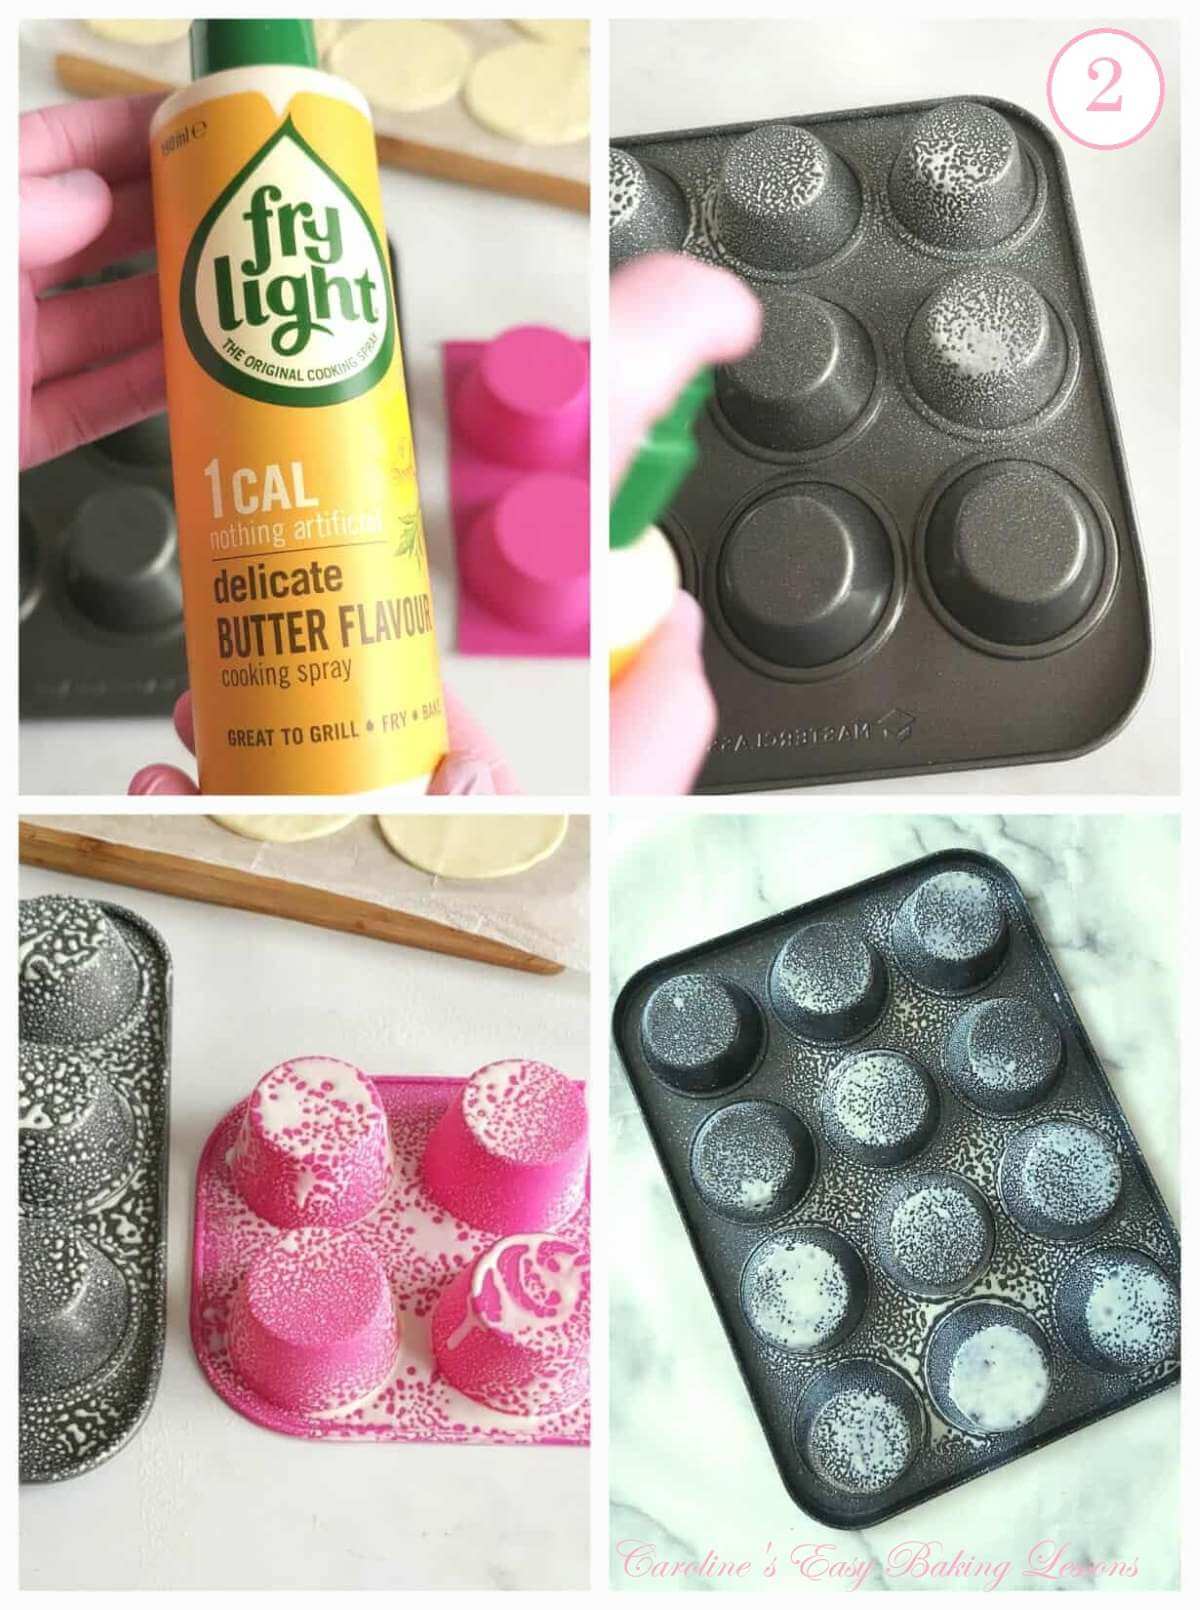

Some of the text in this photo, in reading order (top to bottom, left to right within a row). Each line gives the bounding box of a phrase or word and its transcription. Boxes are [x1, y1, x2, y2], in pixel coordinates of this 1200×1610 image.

[241, 185, 343, 276] fry
[214, 255, 379, 357] light
[222, 338, 246, 362] THE
[244, 355, 305, 381] ORIGINAL
[307, 356, 359, 381] COOKING
[204, 458, 320, 519] 1 CAL
[209, 509, 384, 551] nothing artificial
[213, 561, 343, 604] delicate
[217, 594, 433, 659] BUTTER FLAVOUR
[221, 658, 352, 689] cooking spray
[227, 728, 275, 747] GREAT
[281, 726, 304, 745] TO
[310, 720, 360, 743] GRILL
[381, 711, 407, 733] FRY
